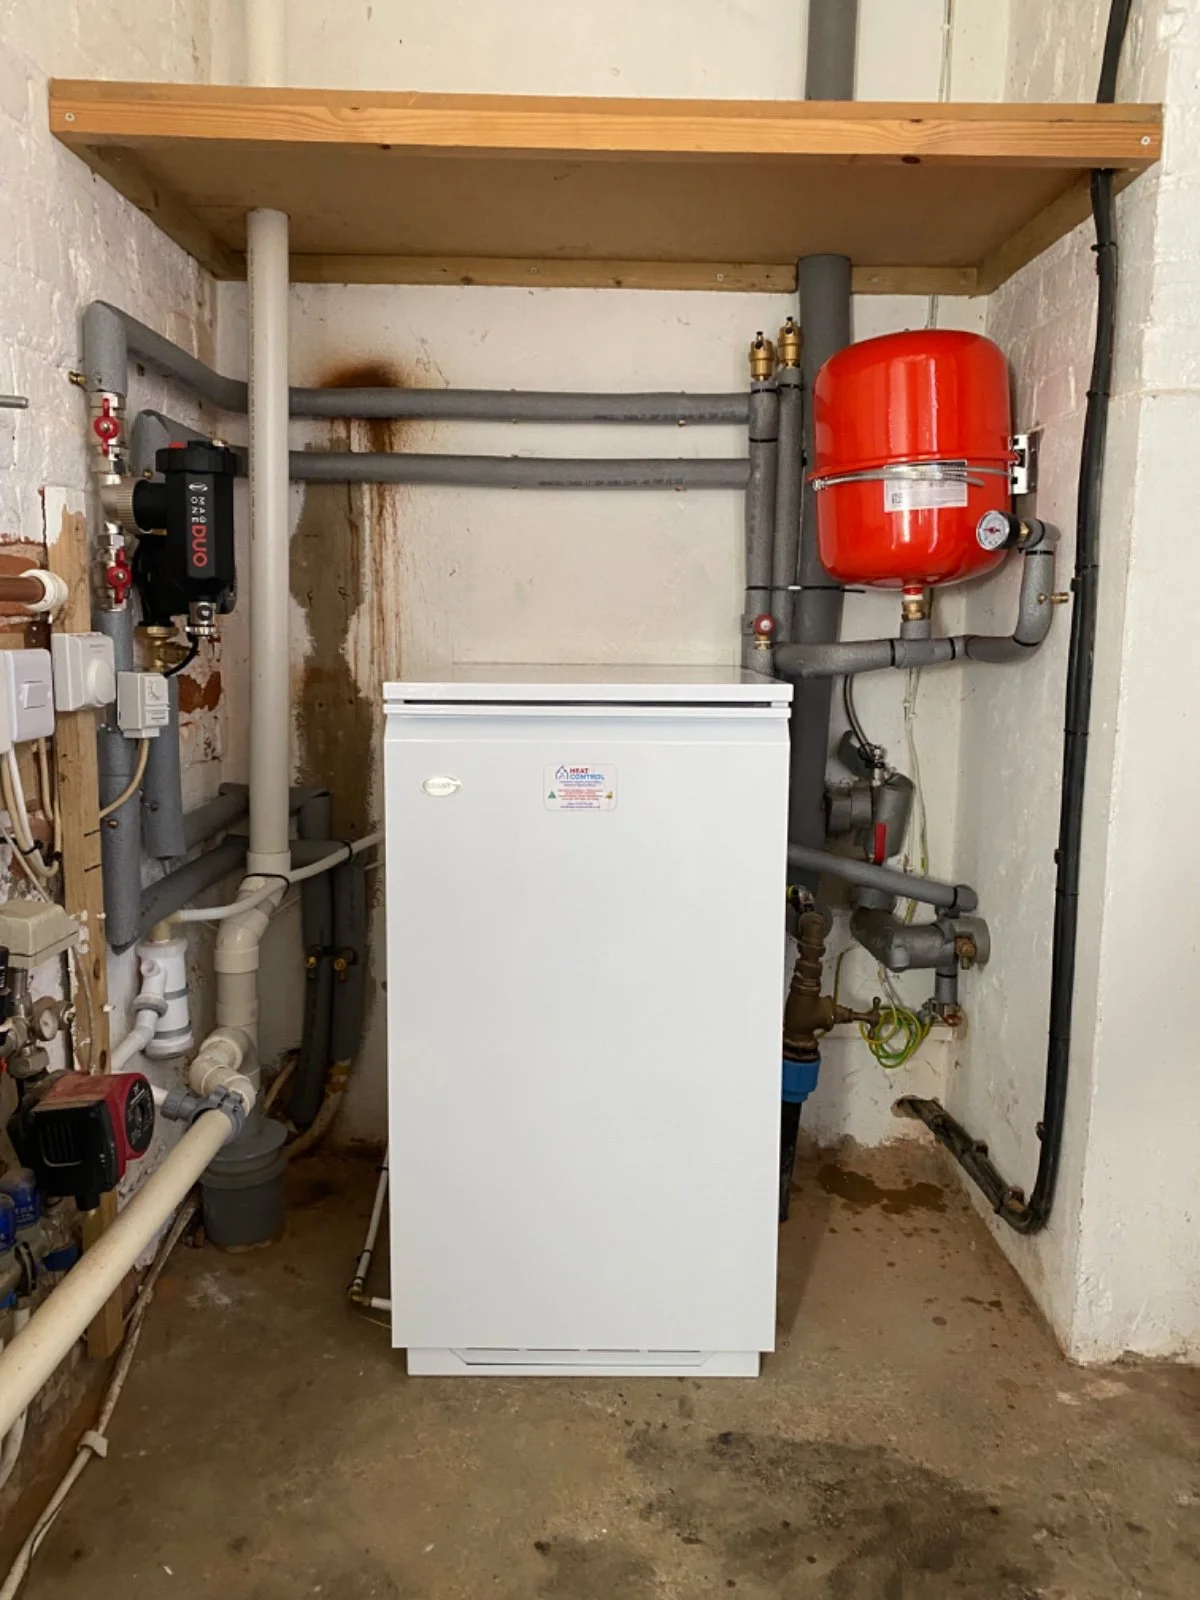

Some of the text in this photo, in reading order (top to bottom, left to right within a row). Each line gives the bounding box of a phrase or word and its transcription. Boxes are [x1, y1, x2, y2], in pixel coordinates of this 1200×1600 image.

[191, 496, 199, 523] ONE
[199, 496, 207, 523] MAG
[192, 525, 208, 568] DUO
